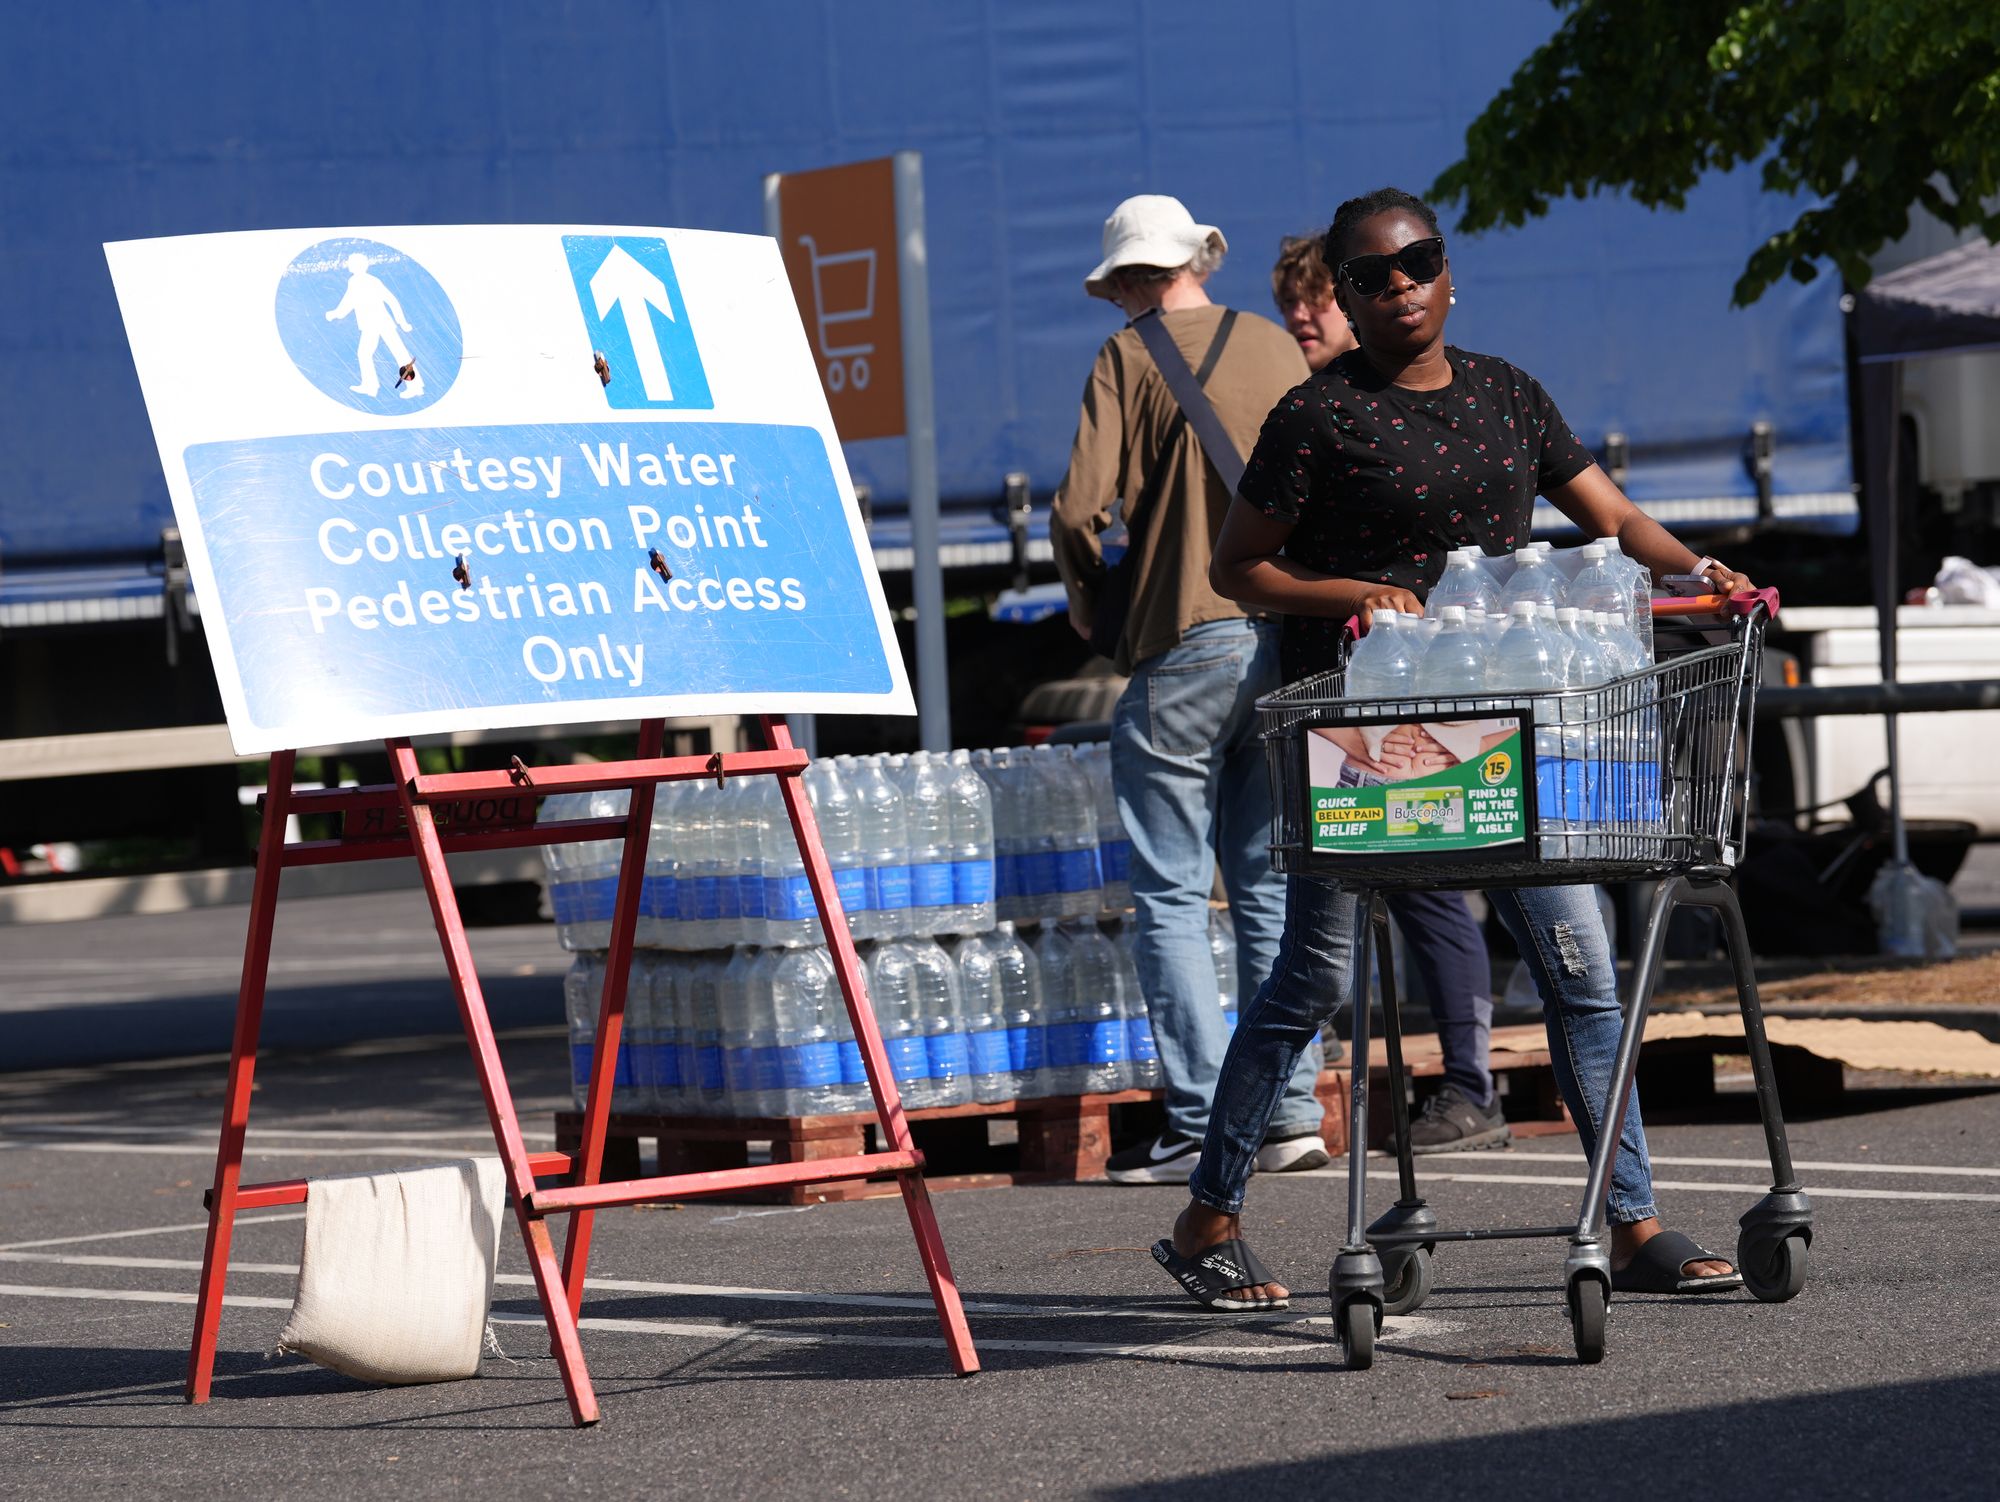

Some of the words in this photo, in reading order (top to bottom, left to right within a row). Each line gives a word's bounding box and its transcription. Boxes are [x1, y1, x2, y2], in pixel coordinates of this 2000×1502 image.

[310, 448, 562, 501] Courtesy
[580, 442, 737, 488] Water
[317, 508, 613, 566] Collection
[627, 504, 769, 550] Point
[304, 573, 612, 634] Pedestrian
[632, 567, 807, 614] Access
[522, 633, 645, 688] Only
[1489, 762, 1505, 776] 15
[1468, 789, 1498, 800] FIND
[1500, 787, 1518, 798] US
[1317, 797, 1357, 809] QUICK
[1473, 800, 1488, 811] IN
[1491, 799, 1514, 810] THE
[1318, 810, 1351, 821] BELLY
[1353, 809, 1381, 819] PAIN
[1394, 807, 1454, 819] Buscopan
[1469, 812, 1519, 823] HEALTH
[1319, 823, 1368, 837] RELIEF
[1476, 823, 1513, 835] AISLE
